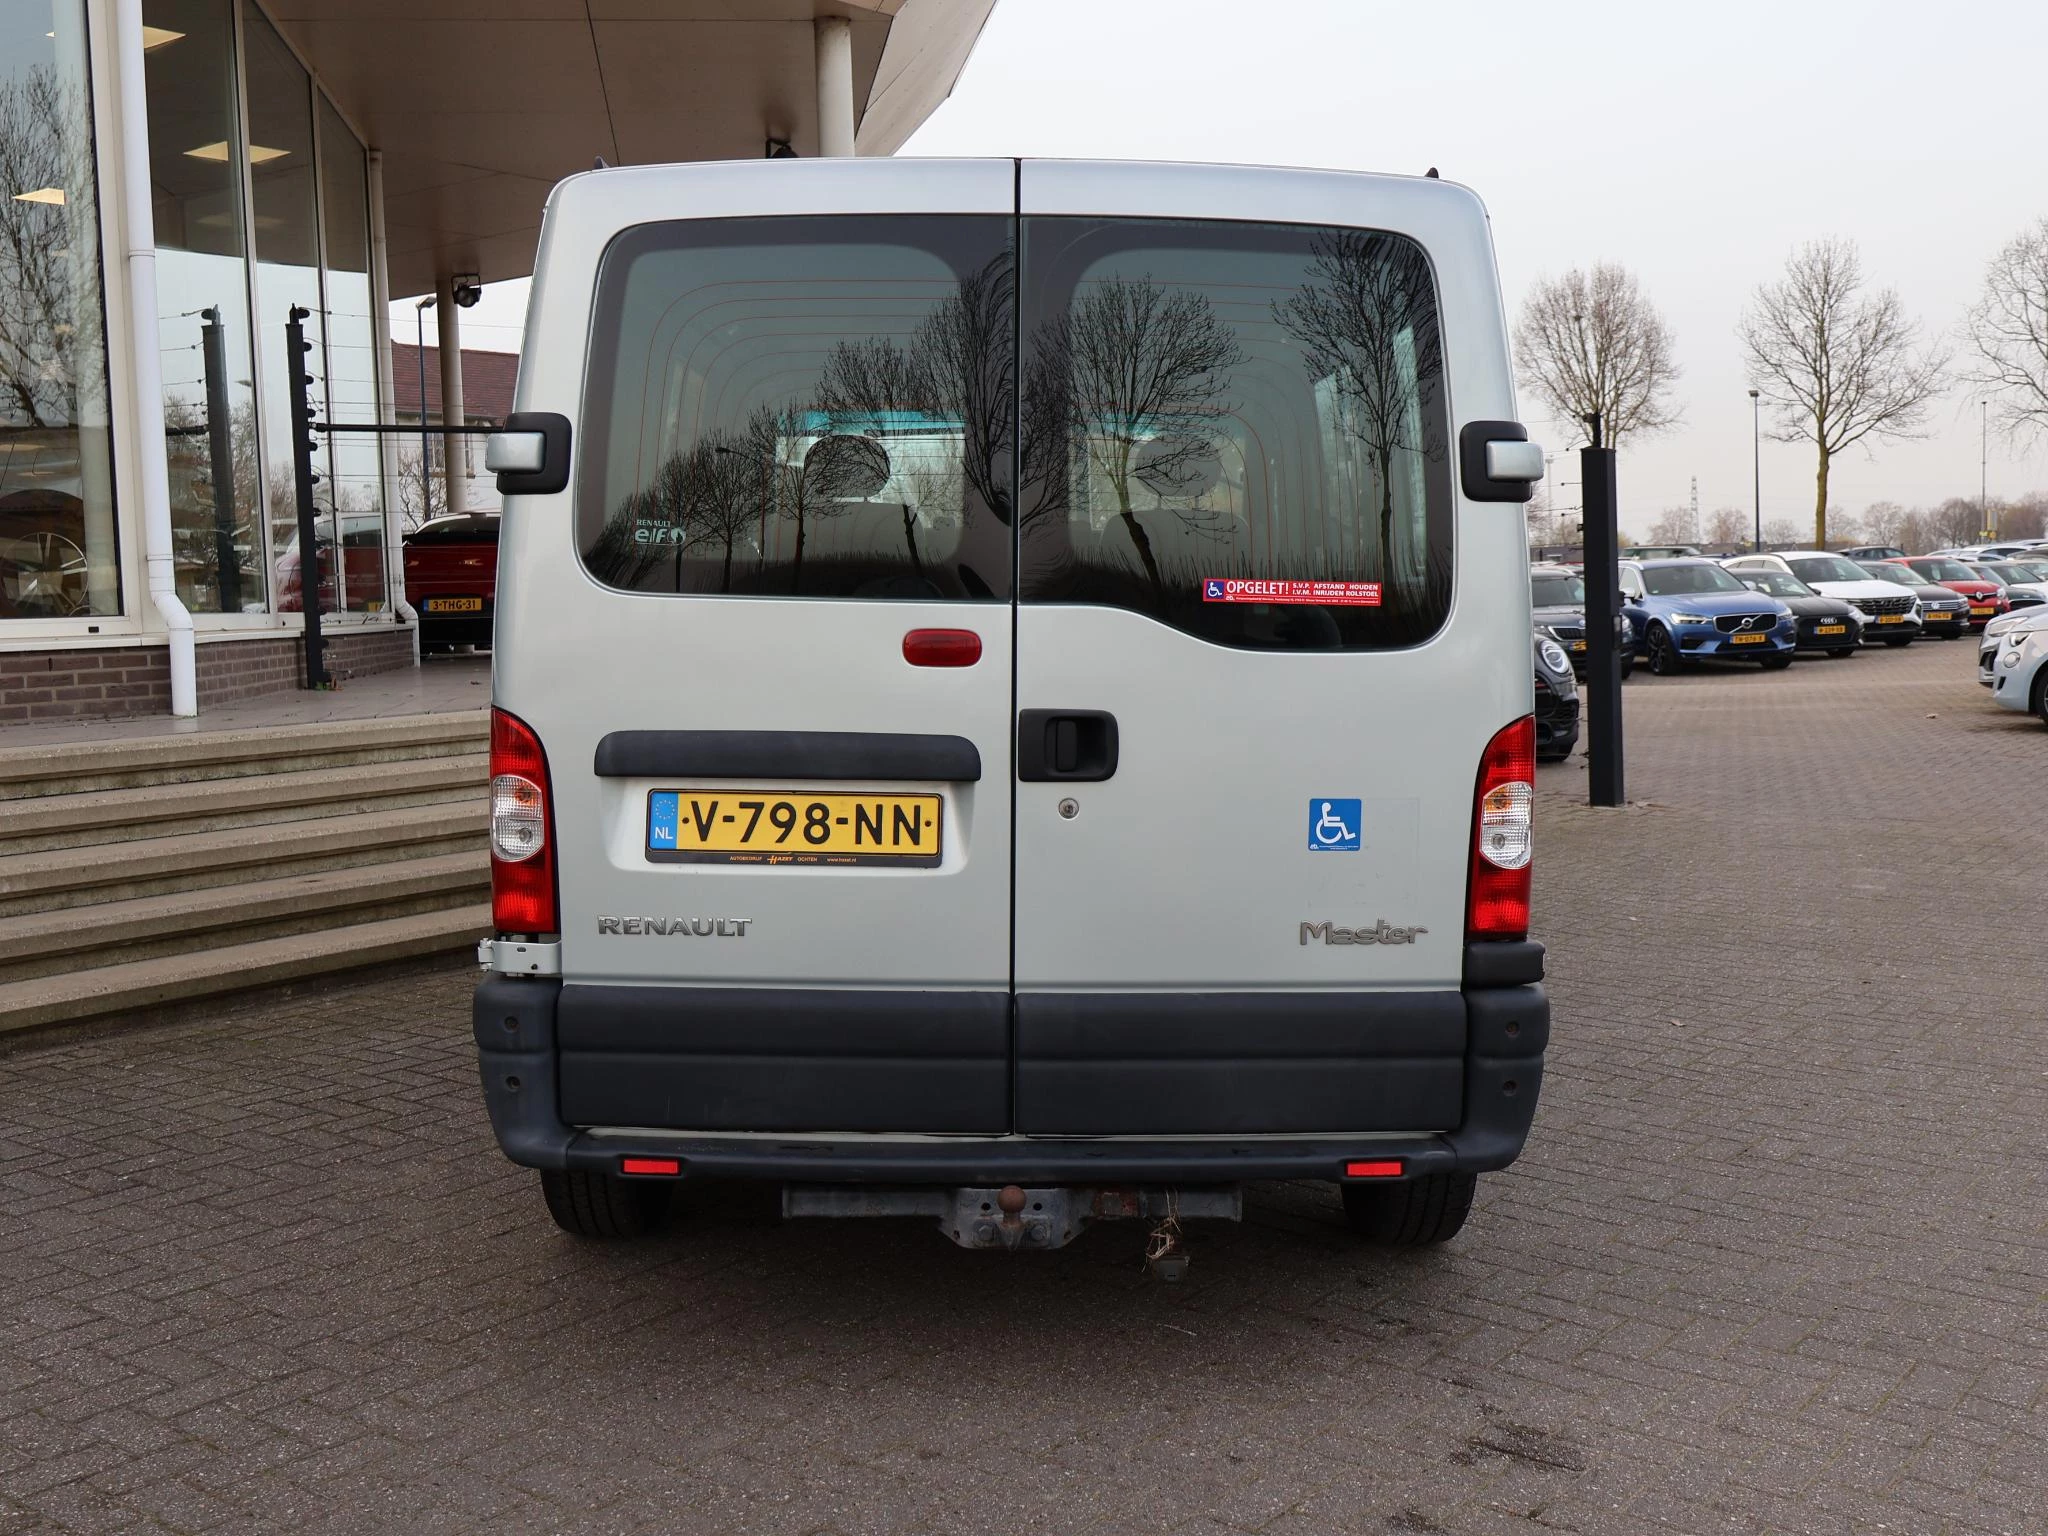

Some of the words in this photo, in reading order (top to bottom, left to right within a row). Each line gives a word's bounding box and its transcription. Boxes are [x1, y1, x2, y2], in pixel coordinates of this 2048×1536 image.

[636, 519, 671, 528] RENAULT
[635, 528, 667, 543] elf
[1226, 580, 1289, 595] OPGELET!
[432, 599, 476, 610] 3-THG-31
[654, 826, 674, 840] NL
[690, 800, 921, 846] V-798-NN
[598, 915, 752, 937] RENAULT
[1300, 918, 1428, 945] Master
